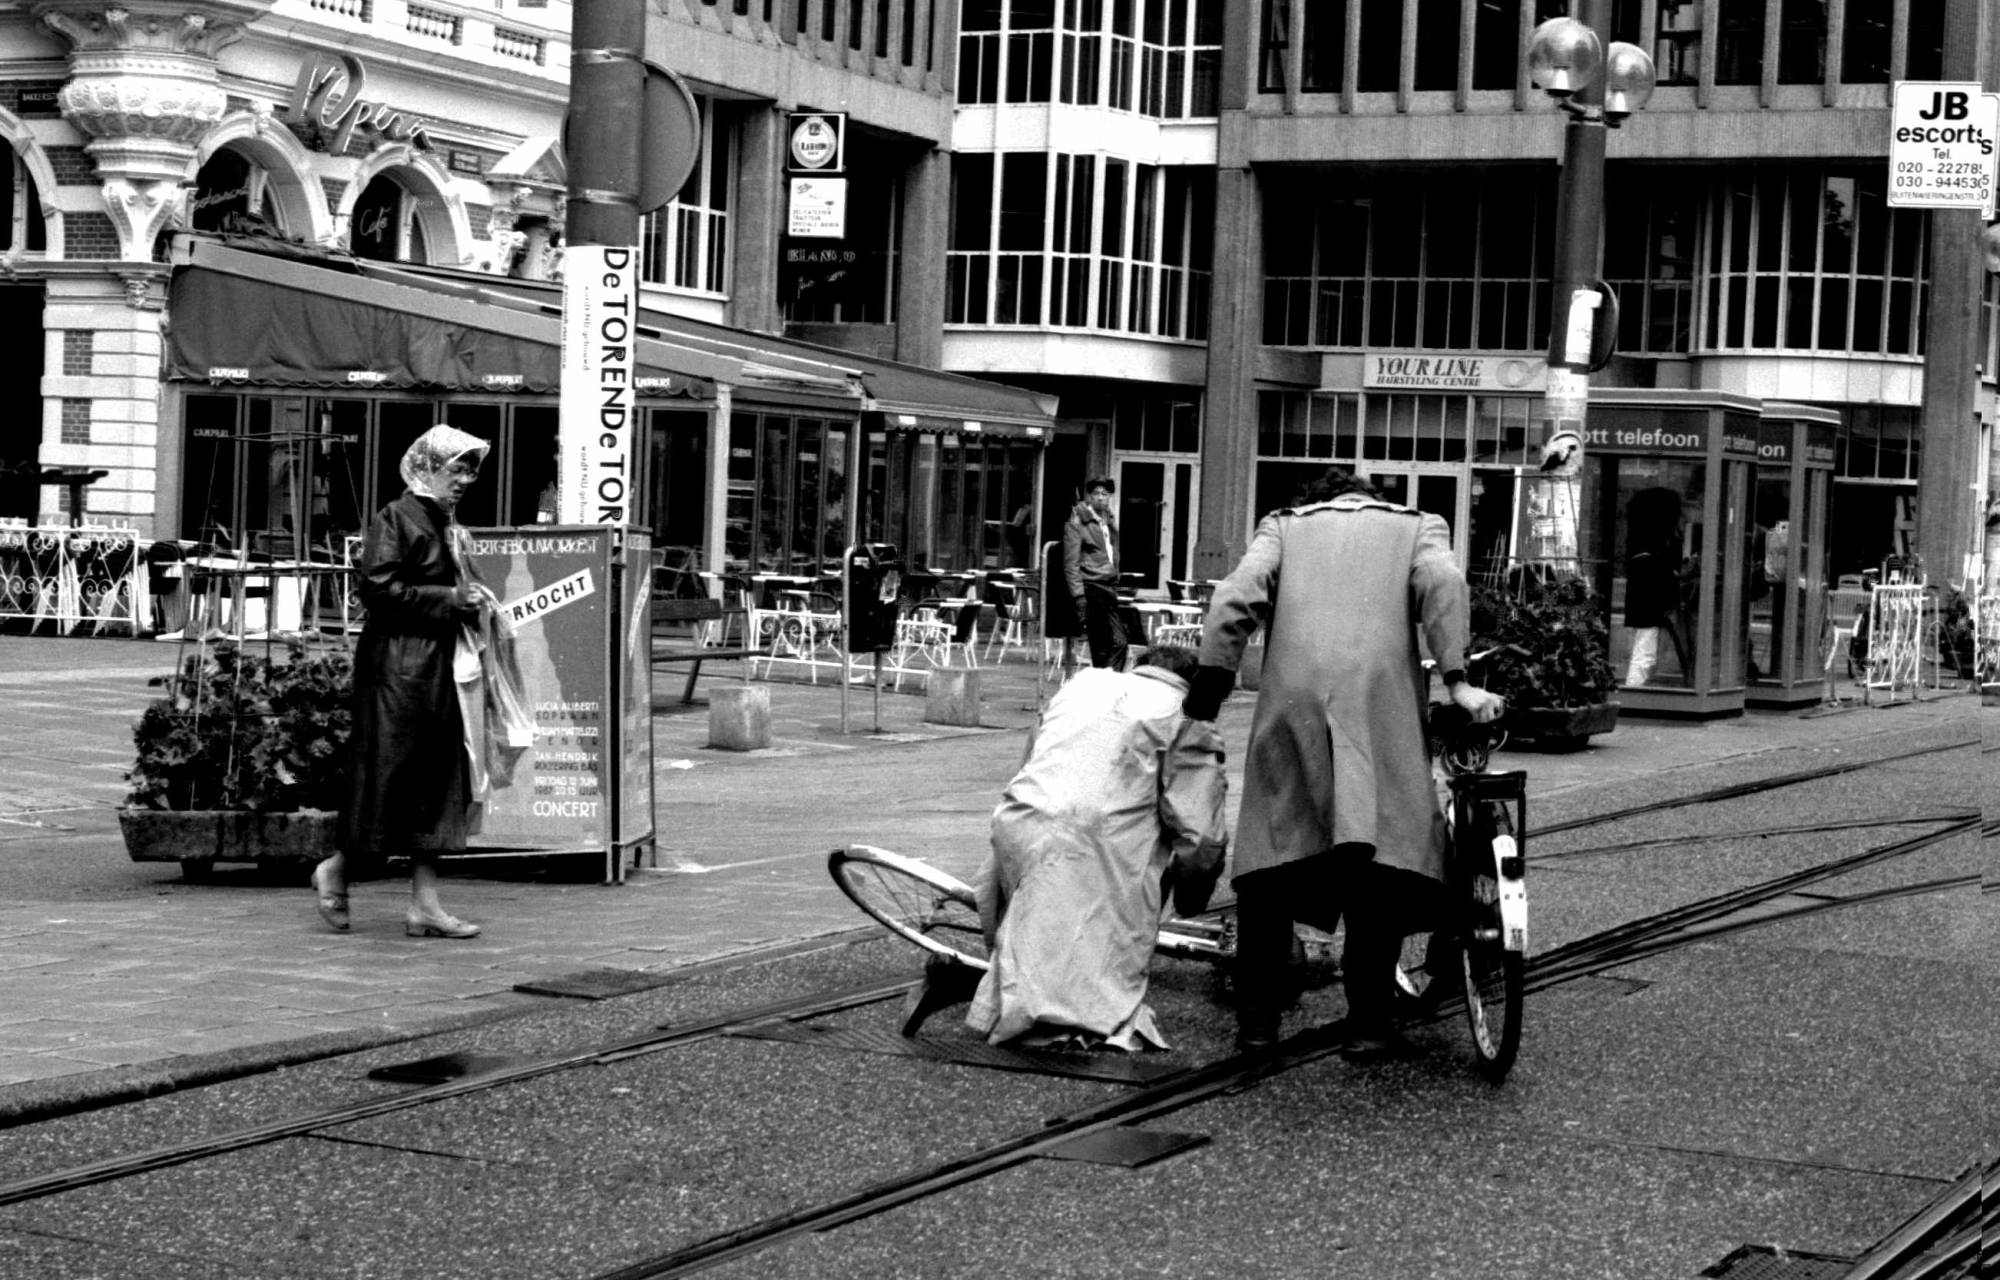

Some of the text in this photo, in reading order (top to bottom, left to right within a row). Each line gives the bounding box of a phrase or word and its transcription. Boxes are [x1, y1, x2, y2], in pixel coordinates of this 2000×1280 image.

[1919, 91, 1969, 121] JB
[1896, 124, 1993, 155] escorts
[1932, 148, 1952, 160] Tel.
[1897, 162, 1924, 173] 020
[1896, 176, 1923, 187] 030
[1377, 357, 1484, 378] YOUR LINE
[1376, 375, 1482, 388] HAIRSTYLING CENTRE
[1615, 428, 1700, 448] telefoon
[505, 576, 587, 622] RKOCHT
[532, 800, 599, 817] CONCERT
